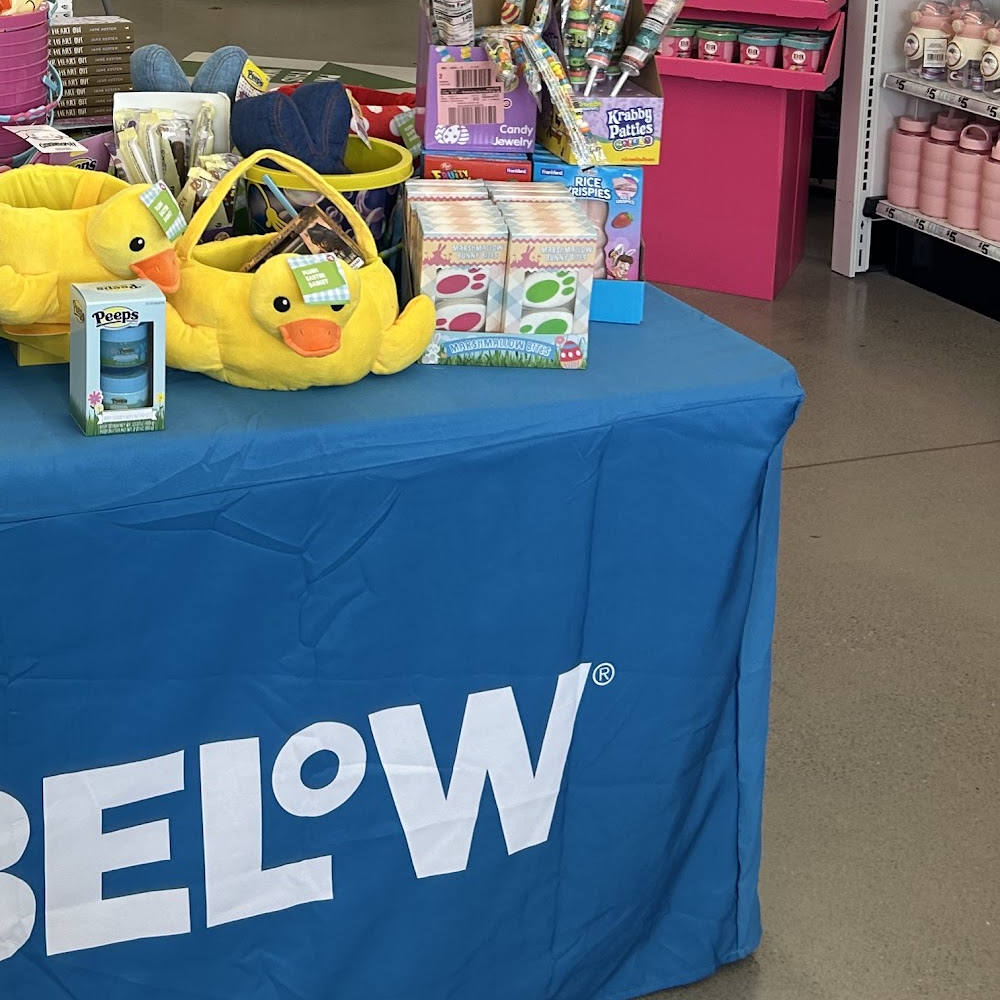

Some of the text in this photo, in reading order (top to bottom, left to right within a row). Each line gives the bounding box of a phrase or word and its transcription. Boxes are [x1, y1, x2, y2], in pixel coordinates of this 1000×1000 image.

[896, 79, 905, 91] $5
[927, 88, 936, 100] $5
[606, 107, 653, 125] Krabby
[987, 105, 997, 118] $5
[499, 124, 534, 137] Candy
[608, 122, 653, 140] Patties
[492, 137, 534, 149] Jewelry
[575, 176, 602, 188] RICE
[886, 206, 895, 219] $5
[946, 230, 957, 243] $5
[91, 309, 139, 327] Peeps
[449, 337, 552, 356] MARSHMALLOW BITES
